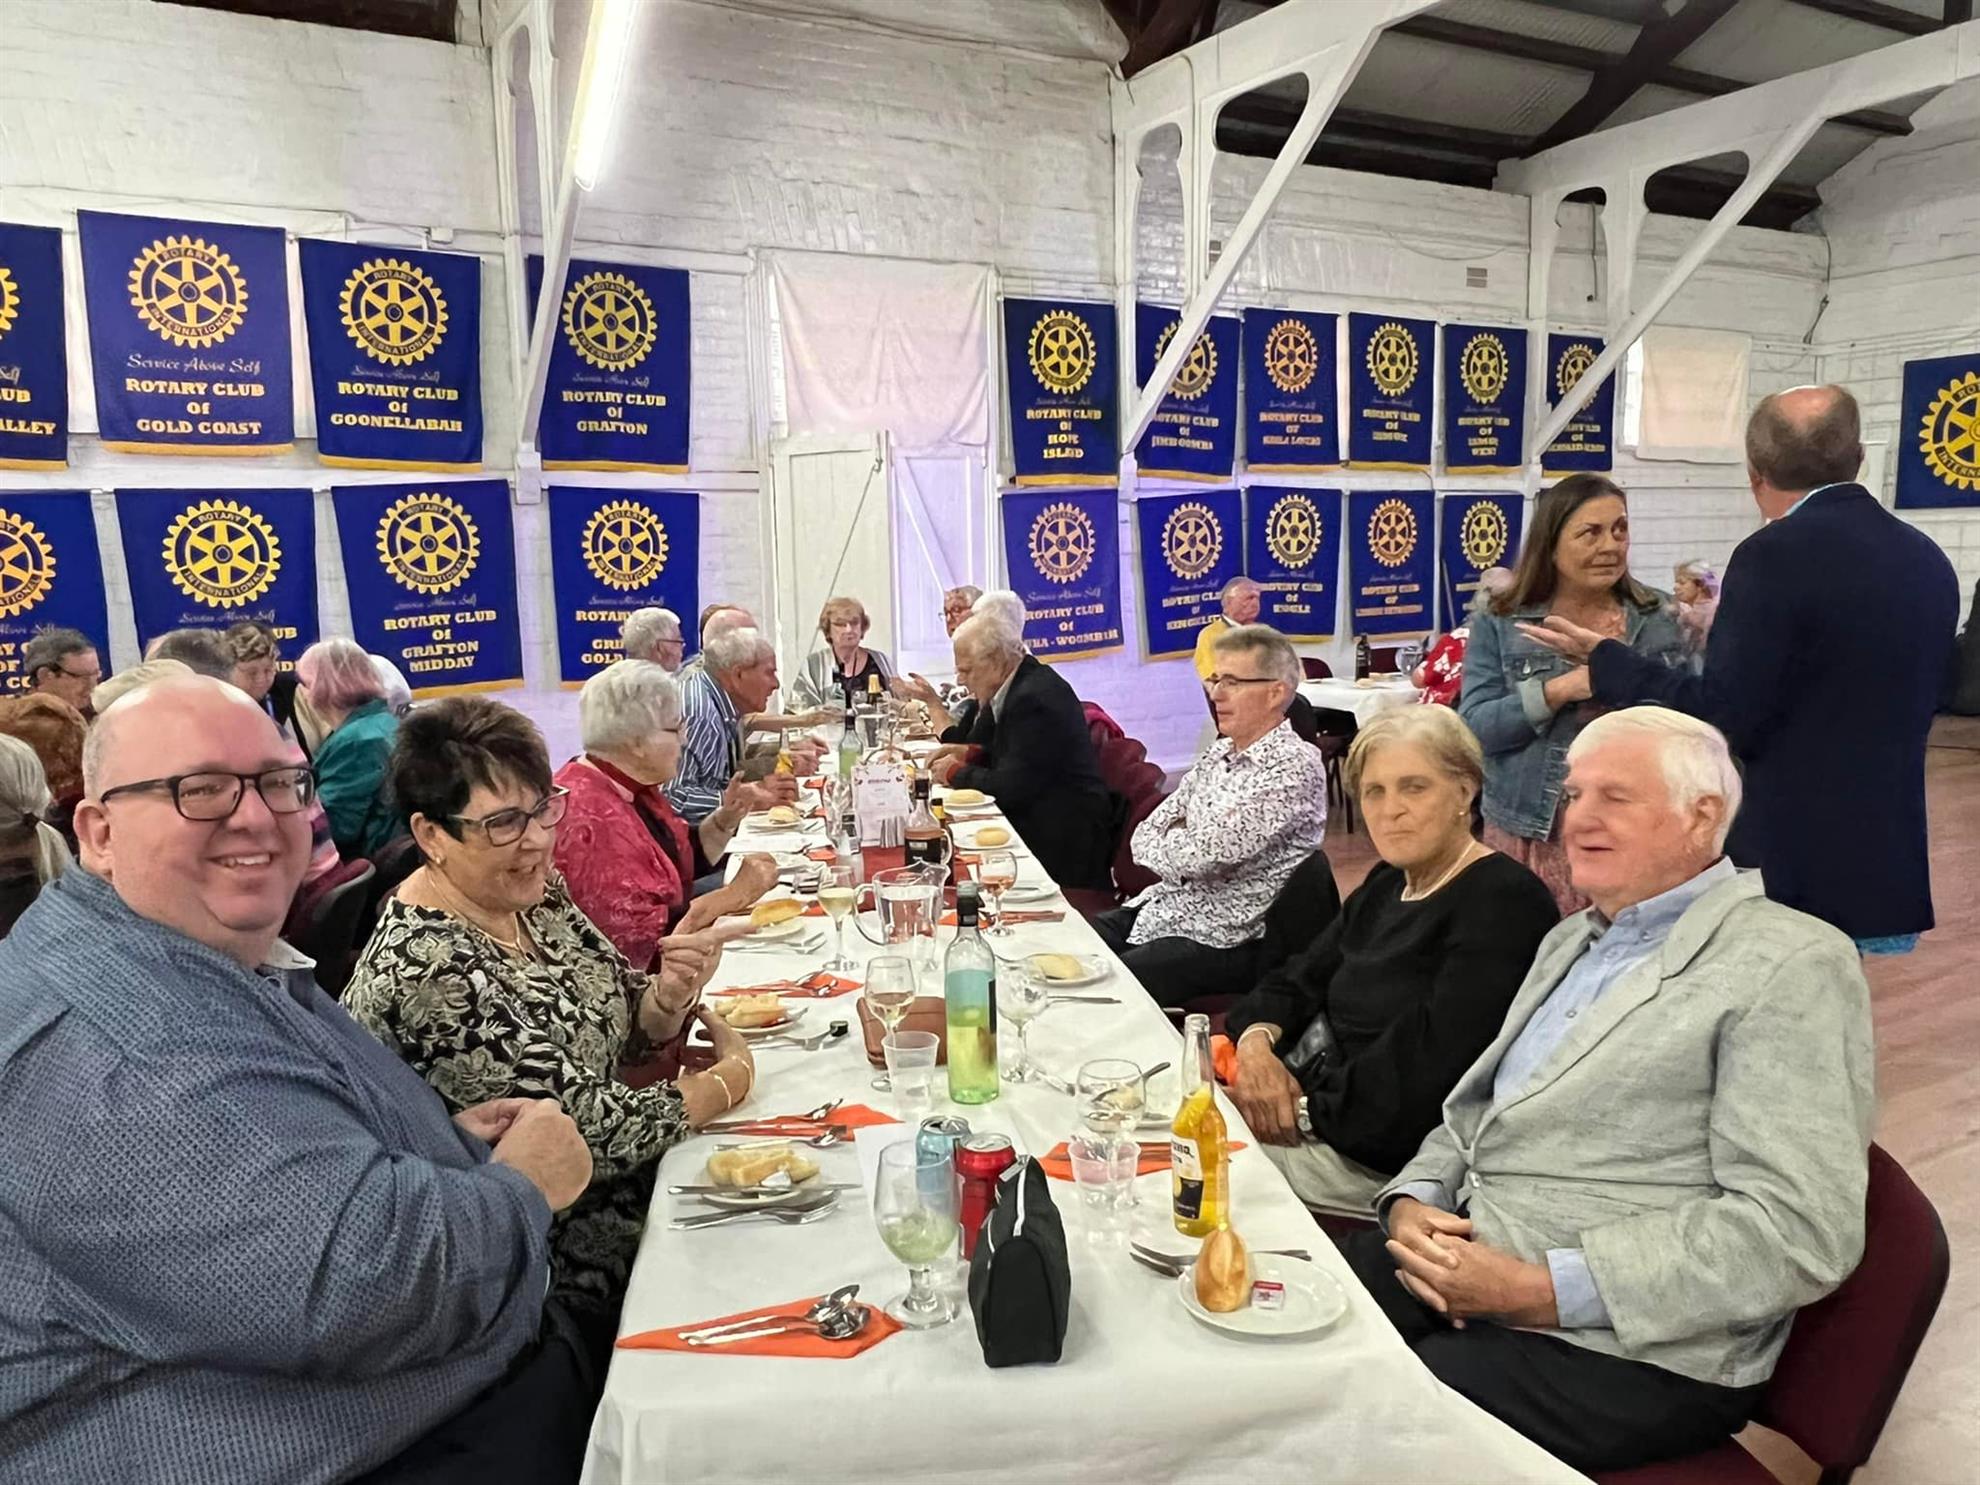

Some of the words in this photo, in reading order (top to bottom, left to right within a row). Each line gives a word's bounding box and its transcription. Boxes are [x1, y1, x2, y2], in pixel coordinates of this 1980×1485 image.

[161, 247, 212, 263] ROTARY
[373, 269, 413, 283] ROTARY
[150, 308, 234, 338] INTERNATIONAL
[358, 324, 433, 355] INTERNATIONAL
[126, 353, 179, 370] Service
[183, 355, 225, 373] Above
[228, 358, 262, 376] Self
[0, 387, 32, 402] UB
[125, 378, 209, 396] ROTARY
[212, 380, 266, 397] CLUB
[337, 381, 409, 398] ROTARY
[413, 386, 459, 401] CLUB
[562, 390, 624, 404] ROTARY
[626, 393, 667, 407] CLUB
[136, 418, 194, 434] GOLD
[198, 420, 262, 435] COAST
[330, 412, 463, 432] GOONELLABAH
[576, 420, 649, 436] GRAFTON
[197, 510, 242, 523] ROTARY
[184, 569, 266, 598] INTERNATIONAL
[383, 613, 452, 632] ROTARY
[454, 609, 498, 625] CLUB
[1024, 607, 1073, 621] ROTARY
[1075, 603, 1105, 616] CLUB
[272, 626, 298, 639] UB
[401, 640, 480, 660] GRAFTON
[581, 653, 624, 664] GOLD
[409, 655, 476, 673] MIDDAY
